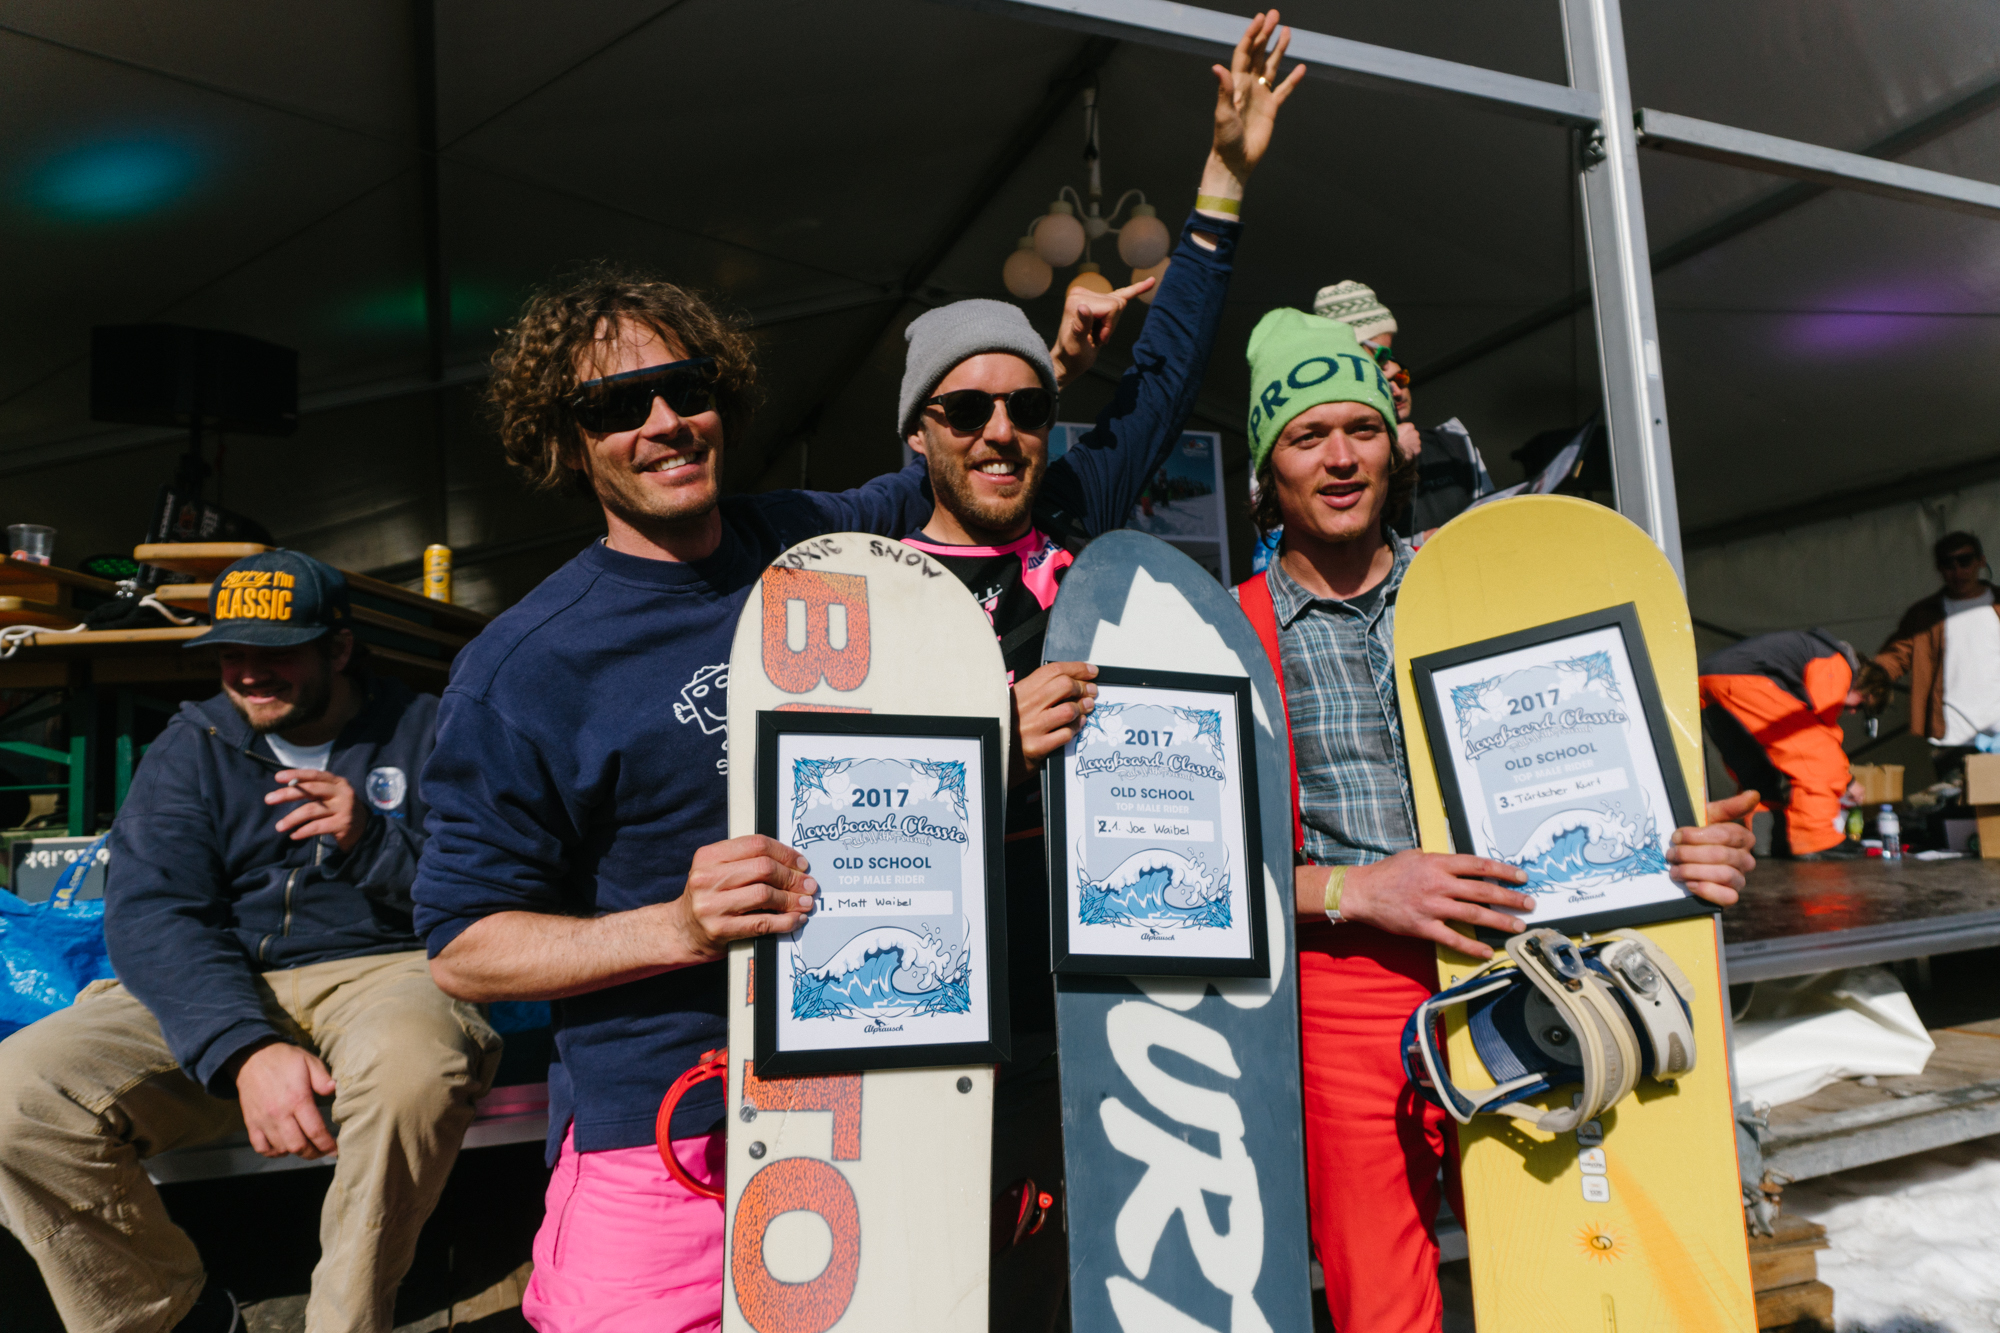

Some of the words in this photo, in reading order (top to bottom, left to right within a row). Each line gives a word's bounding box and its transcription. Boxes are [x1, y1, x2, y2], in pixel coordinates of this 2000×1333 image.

[870, 540, 942, 578] SNOW
[215, 588, 293, 620] CLASSIC
[1507, 688, 1561, 716] 2017
[1124, 729, 1174, 747] 2017
[1465, 714, 1556, 761] Longboard
[1559, 709, 1627, 728] Classic
[1076, 751, 1164, 778] Longboard
[1167, 754, 1225, 781] Classic
[1505, 757, 1533, 771] OLD
[1536, 743, 1598, 764] SCHOOL
[1513, 772, 1534, 783] TOP
[1536, 767, 1563, 780] MALE
[1565, 759, 1594, 773] RIDER
[851, 788, 909, 808] 2017
[1110, 786, 1137, 799] OLD
[1140, 788, 1195, 801] SCHOOL
[1500, 797, 1515, 809] 3.
[1575, 778, 1601, 790] Kurt
[1115, 802, 1135, 812] TOP
[1136, 803, 1161, 813] MALE
[1163, 804, 1190, 814] RIDER
[792, 813, 897, 849] Longboard
[900, 815, 967, 844] Classic
[1126, 821, 1147, 834] Joe
[1154, 823, 1190, 836] Waibel
[833, 857, 864, 870] OLD
[868, 857, 932, 869] SCHOOL
[838, 875, 860, 885] TOP
[863, 874, 892, 885] MALE
[894, 874, 925, 885] RIDER
[817, 897, 834, 911] 1.
[838, 898, 867, 909] Matt
[875, 896, 912, 908] Waibel
